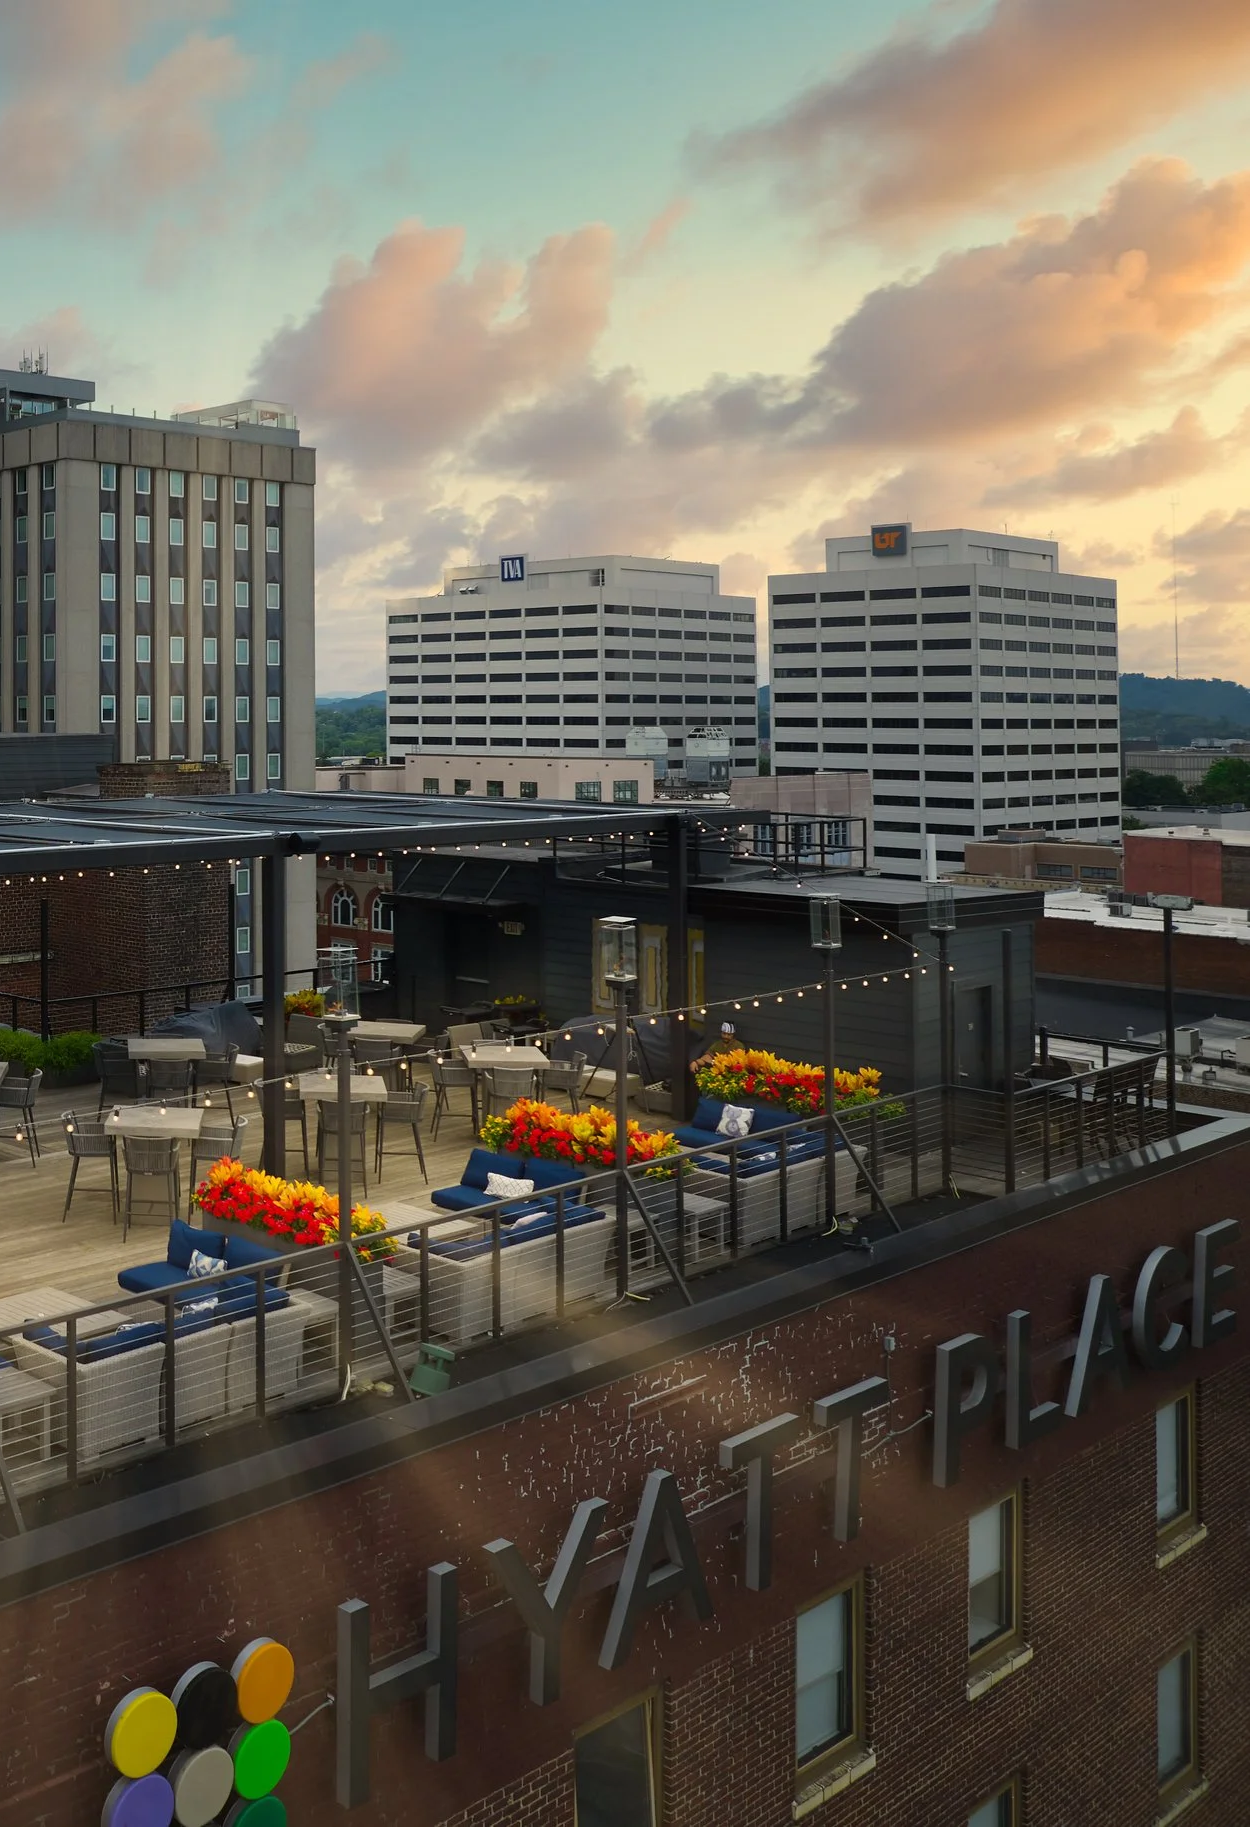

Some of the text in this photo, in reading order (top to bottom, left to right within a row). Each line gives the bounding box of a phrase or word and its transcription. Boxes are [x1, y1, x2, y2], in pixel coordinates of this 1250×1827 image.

[874, 532, 902, 549] UT
[502, 559, 522, 579] TVA
[337, 1219, 1241, 1809] HYATT PLACE
